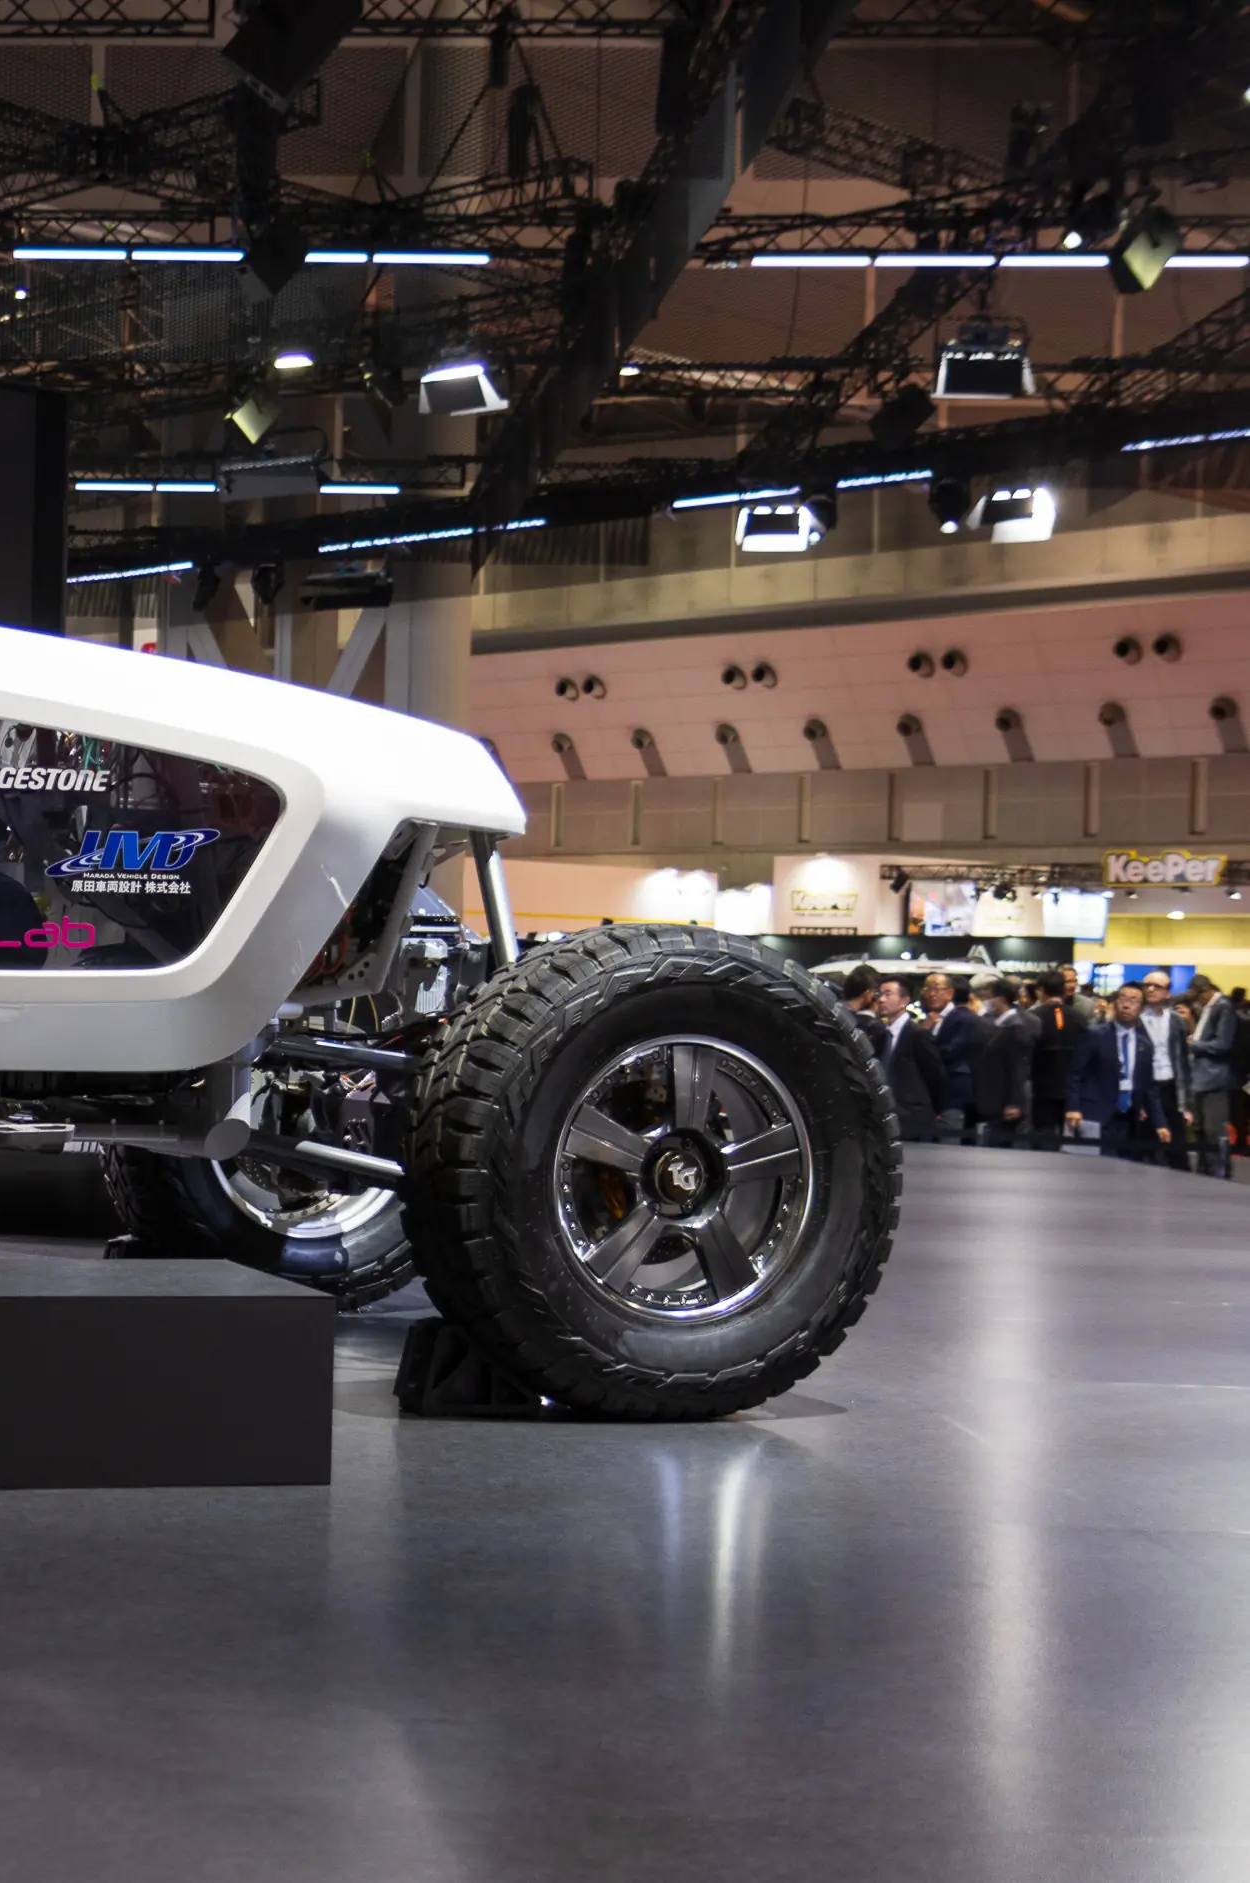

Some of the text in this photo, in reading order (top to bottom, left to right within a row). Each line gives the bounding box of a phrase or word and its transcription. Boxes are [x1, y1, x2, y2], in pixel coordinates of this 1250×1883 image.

[1107, 853, 1220, 883] KeePer
[145, 881, 191, 894] 株式会社
